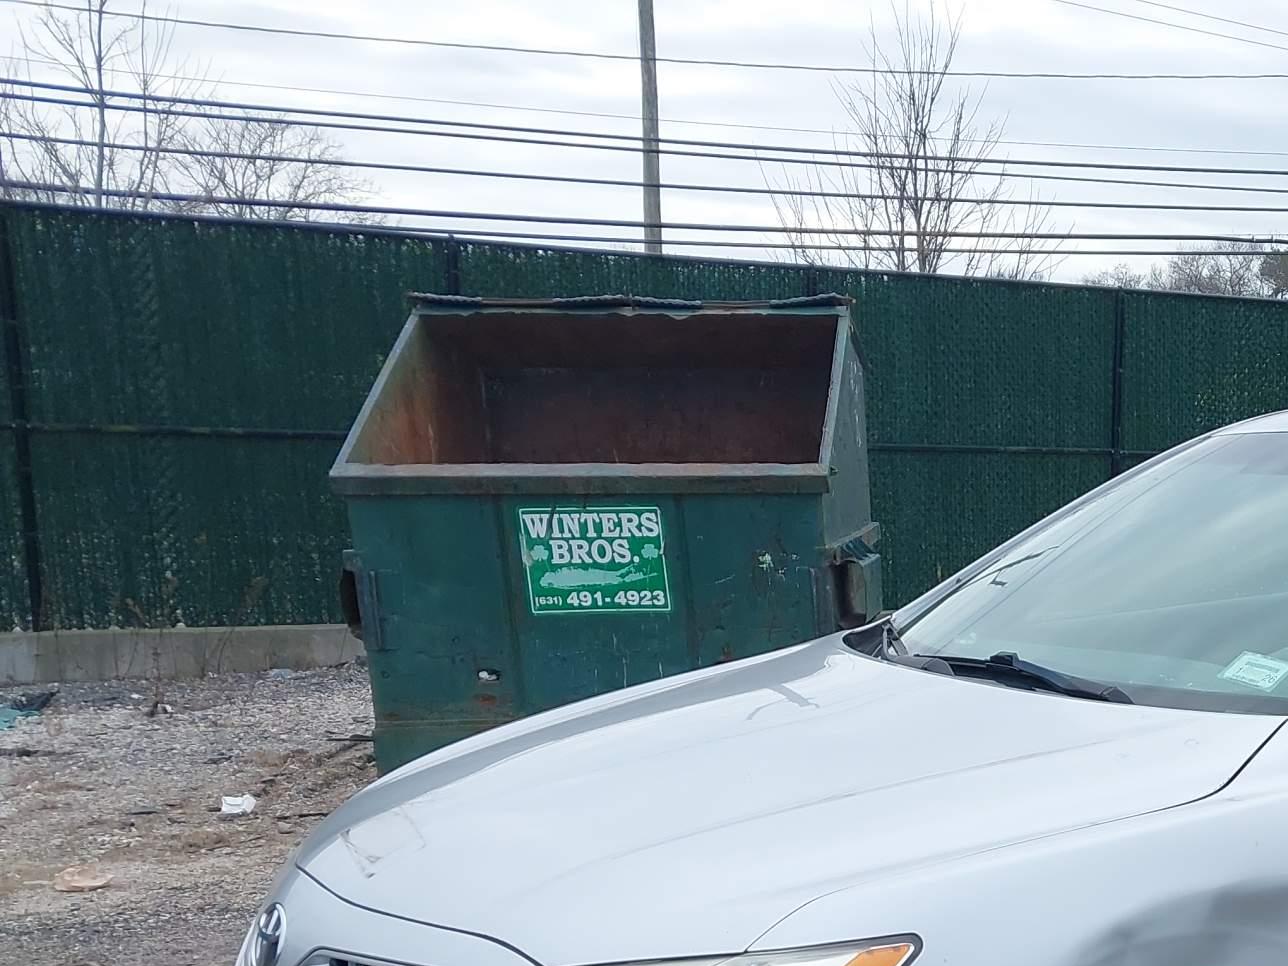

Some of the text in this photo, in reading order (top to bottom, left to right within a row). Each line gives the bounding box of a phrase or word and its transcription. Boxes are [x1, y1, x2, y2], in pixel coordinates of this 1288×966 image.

[523, 513, 659, 539] WINTERS
[549, 538, 640, 564] BROS.
[535, 590, 665, 607] (631) 491-4923
